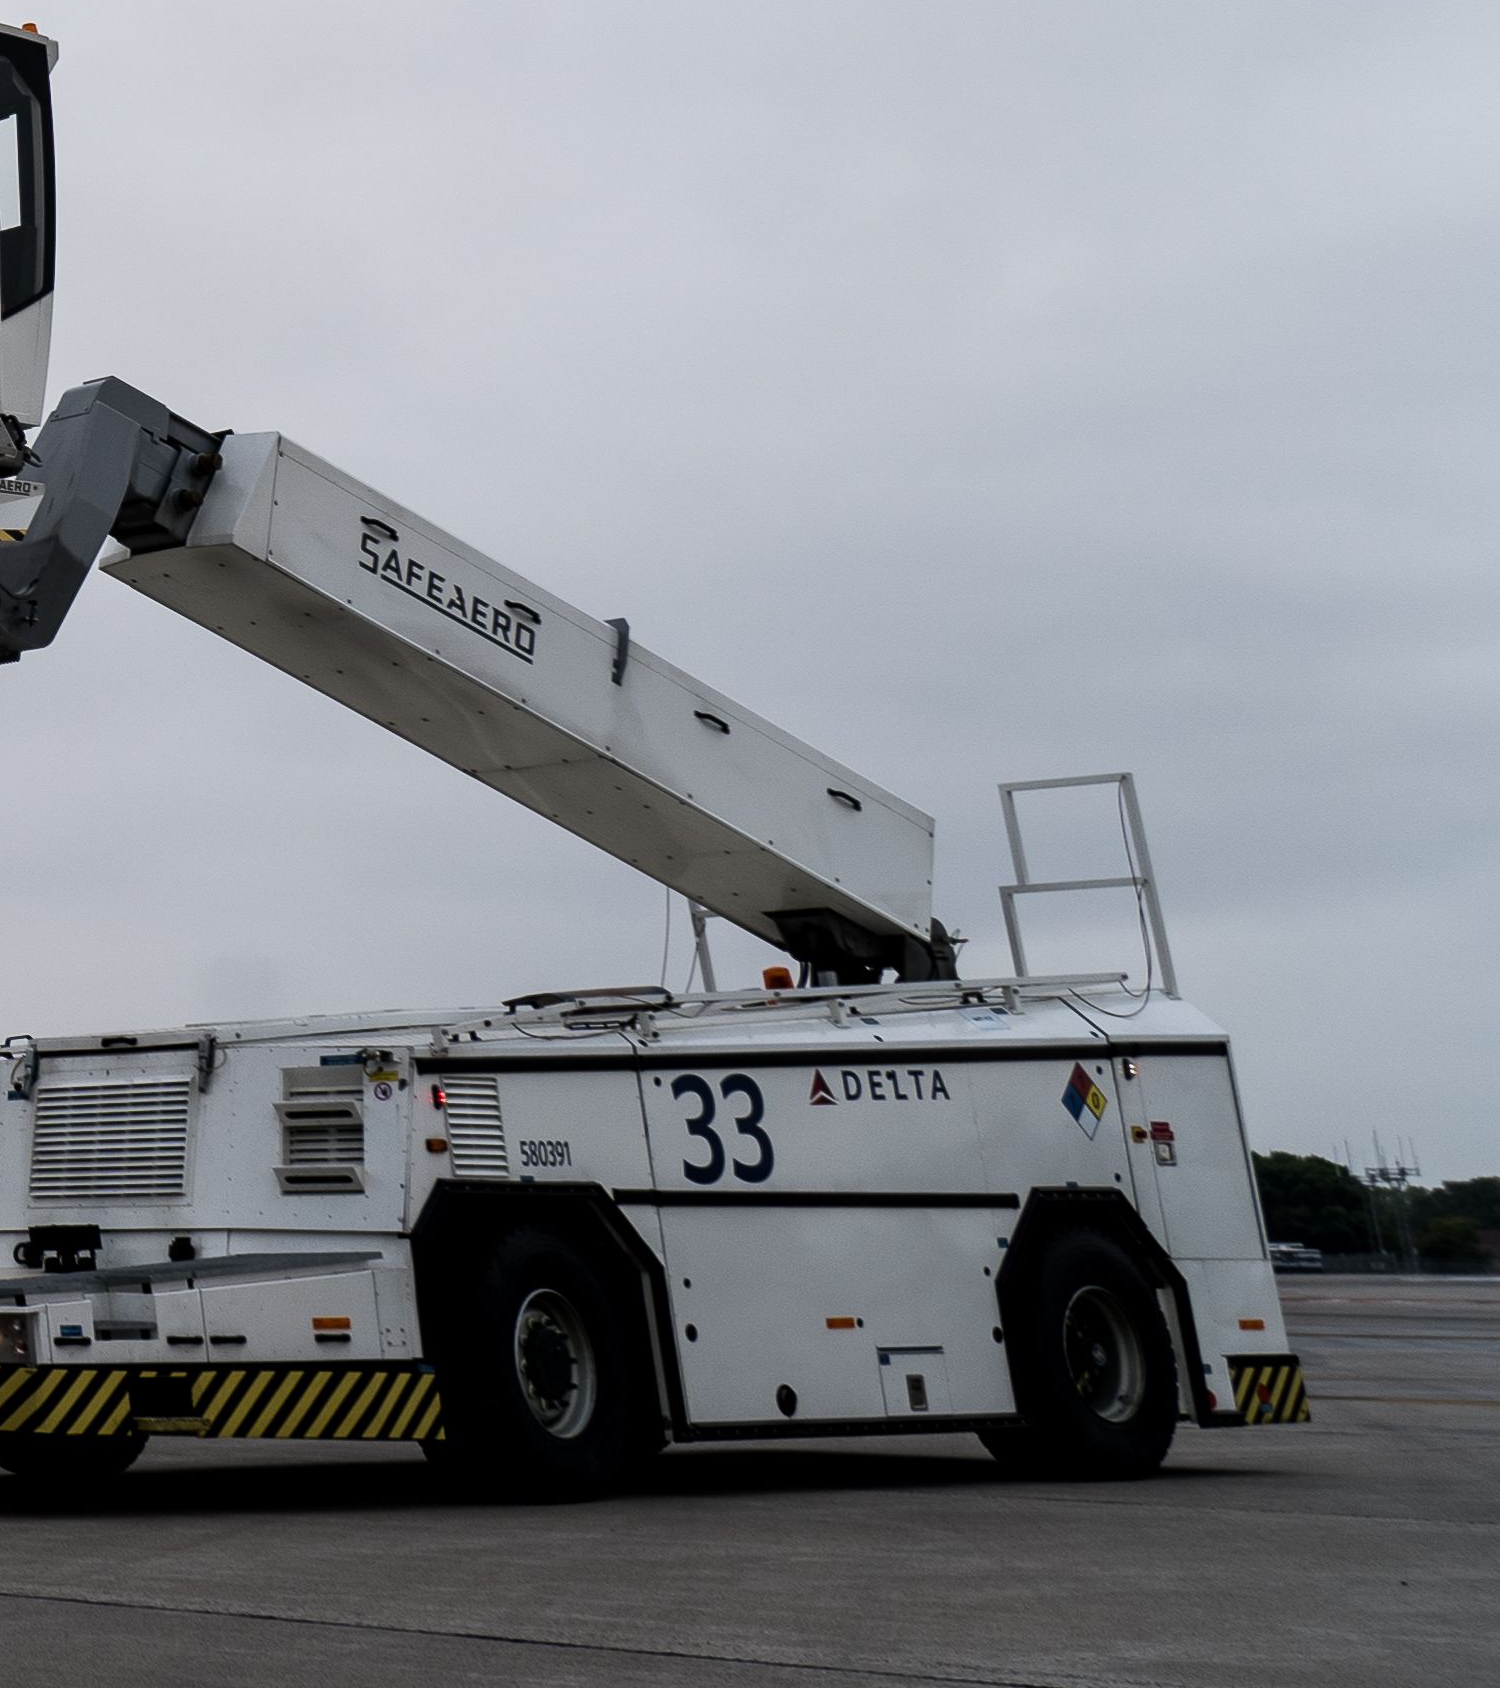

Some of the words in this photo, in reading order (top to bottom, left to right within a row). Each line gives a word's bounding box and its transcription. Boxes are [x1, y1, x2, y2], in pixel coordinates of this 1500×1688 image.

[358, 531, 537, 657] SAFEAERO
[842, 1069, 950, 1101] DELTA
[519, 1140, 572, 1169] 580391
[671, 1073, 774, 1185] 33
